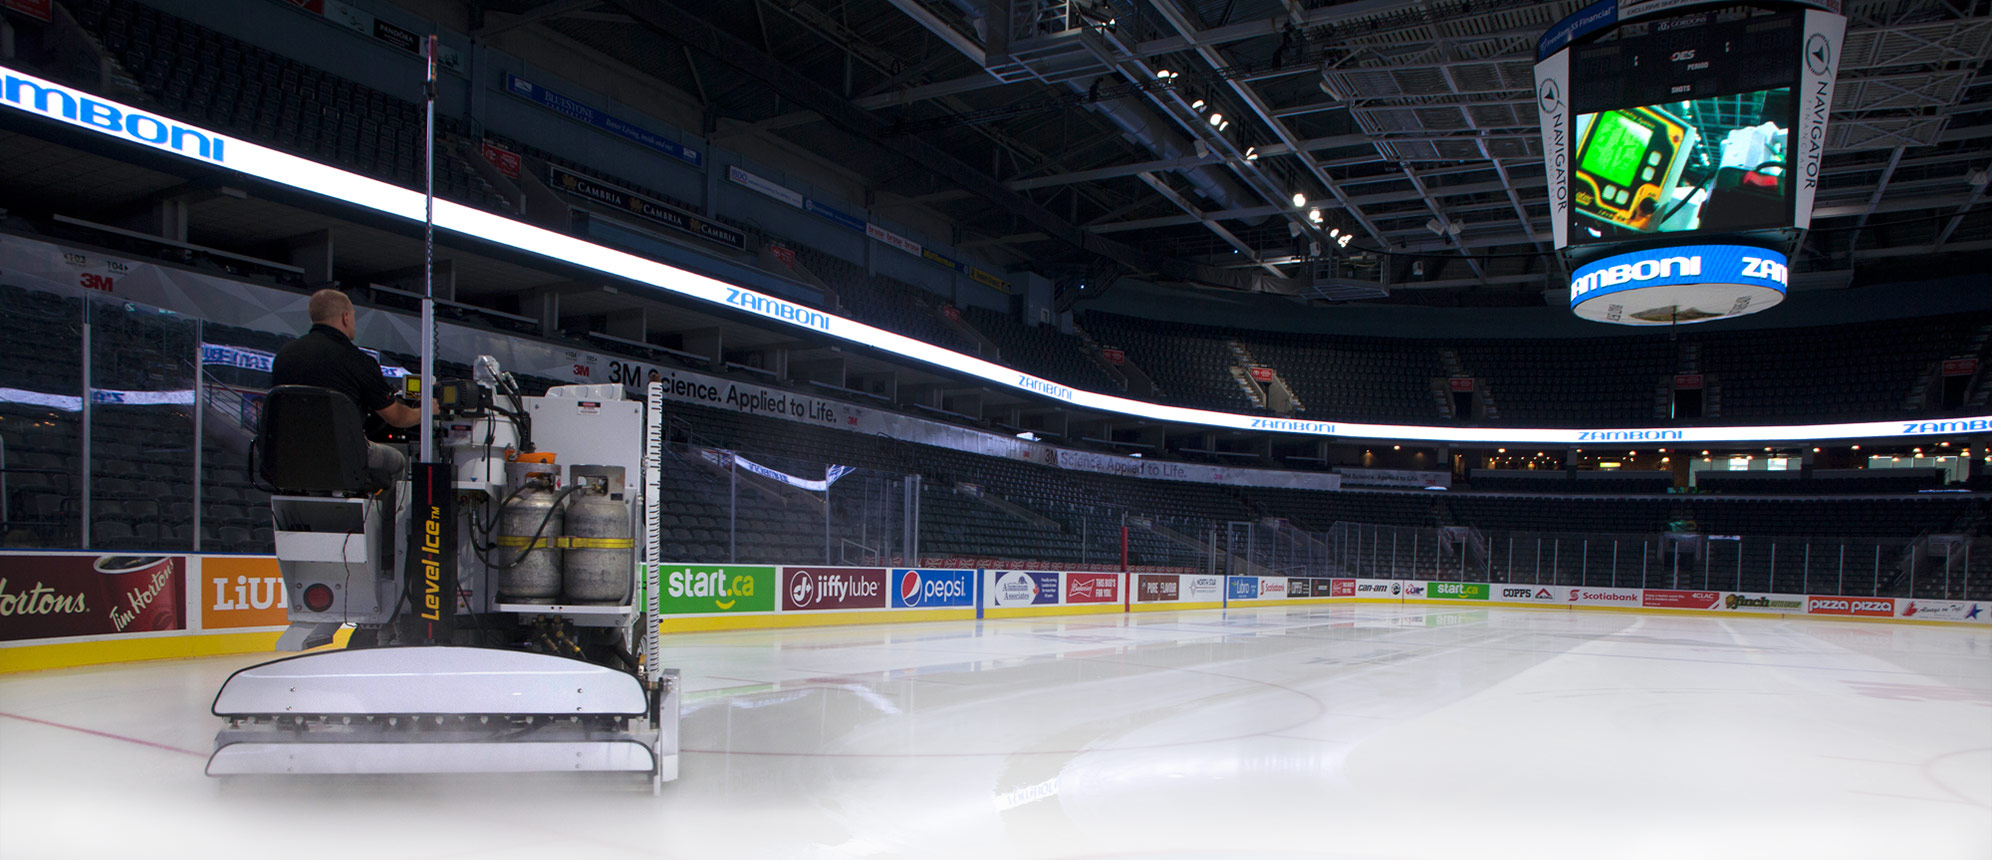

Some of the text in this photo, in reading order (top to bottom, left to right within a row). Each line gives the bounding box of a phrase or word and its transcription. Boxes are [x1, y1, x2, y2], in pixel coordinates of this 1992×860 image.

[1687, 62, 1709, 71] PERIOD
[1671, 85, 1691, 94] SHOTS
[545, 90, 594, 117] BLUESTONE
[0, 75, 224, 162] MBONI
[1804, 81, 1829, 190] NAVIGATOR
[1552, 113, 1567, 213] NAVIGATOR
[732, 169, 748, 181] BDO
[576, 181, 623, 205] CAMBRIA
[642, 203, 683, 226] CAMBRIA
[701, 223, 737, 244] CAMBRIA
[80, 273, 113, 292] 3M
[726, 287, 830, 330] ZAMBONI
[573, 364, 590, 376] 3M
[608, 361, 641, 387] 3M
[726, 385, 786, 413] Applied
[790, 398, 804, 417] to
[809, 401, 838, 423] Life.
[1018, 375, 1072, 401] ZAMBONI
[1251, 418, 1336, 434] ZAMBONI
[1578, 430, 1683, 441] ZAMBONI
[1903, 419, 1992, 434] ZAMB
[1045, 448, 1187, 479] 3M Science. Applied to Life.
[668, 568, 755, 598] start.ca
[924, 576, 966, 602] pepsi
[1437, 584, 1479, 595] start.ca
[1503, 588, 1531, 598] COPPS
[109, 558, 175, 633] Tim Hortons
[1582, 592, 1638, 601] Scotiabank
[1809, 599, 1892, 614] pizza pizza
